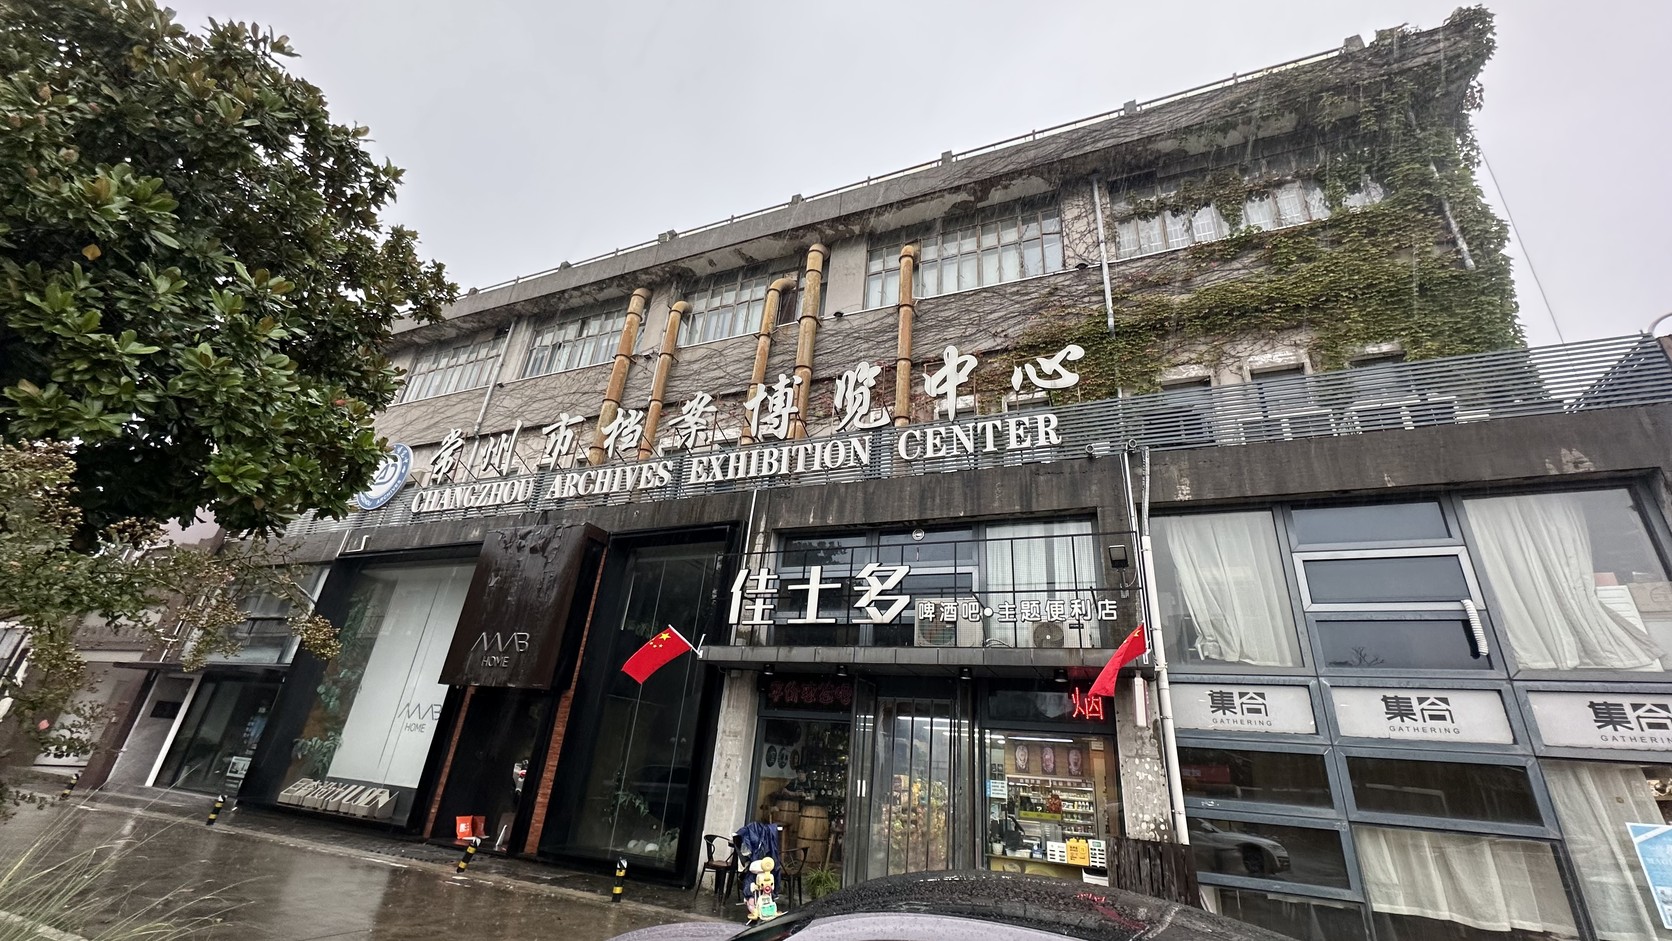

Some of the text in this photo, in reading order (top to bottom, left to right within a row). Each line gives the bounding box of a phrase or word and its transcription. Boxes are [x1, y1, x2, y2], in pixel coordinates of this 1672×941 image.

[410, 413, 1063, 514] CHANGZHOU ARCHIVES EXHIBITION CENTER
[481, 656, 509, 668] HOME
[1071, 686, 1103, 720] 烟
[404, 722, 426, 733] HOME
[1212, 718, 1273, 727] GATHERING
[1389, 725, 1461, 735] GATHERING
